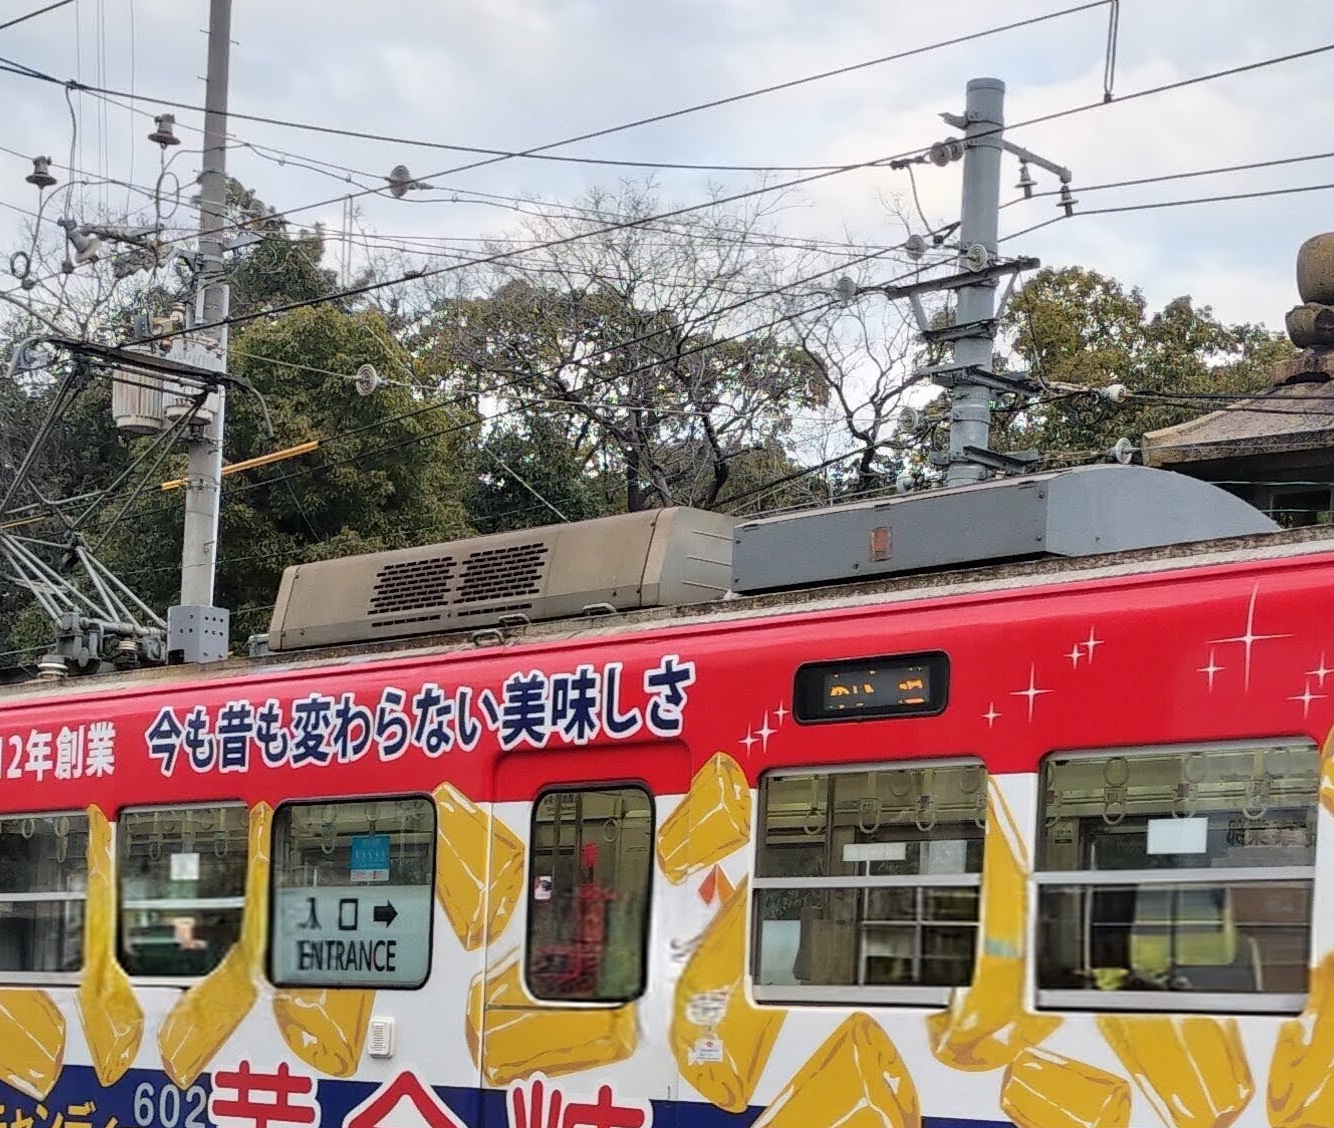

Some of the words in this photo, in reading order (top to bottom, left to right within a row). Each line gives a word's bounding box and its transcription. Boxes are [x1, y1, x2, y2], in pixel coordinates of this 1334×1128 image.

[146, 653, 696, 778] 今も昔も変わらない美味しさ
[297, 897, 359, 931] 入口
[298, 939, 396, 972] ENTRANCE
